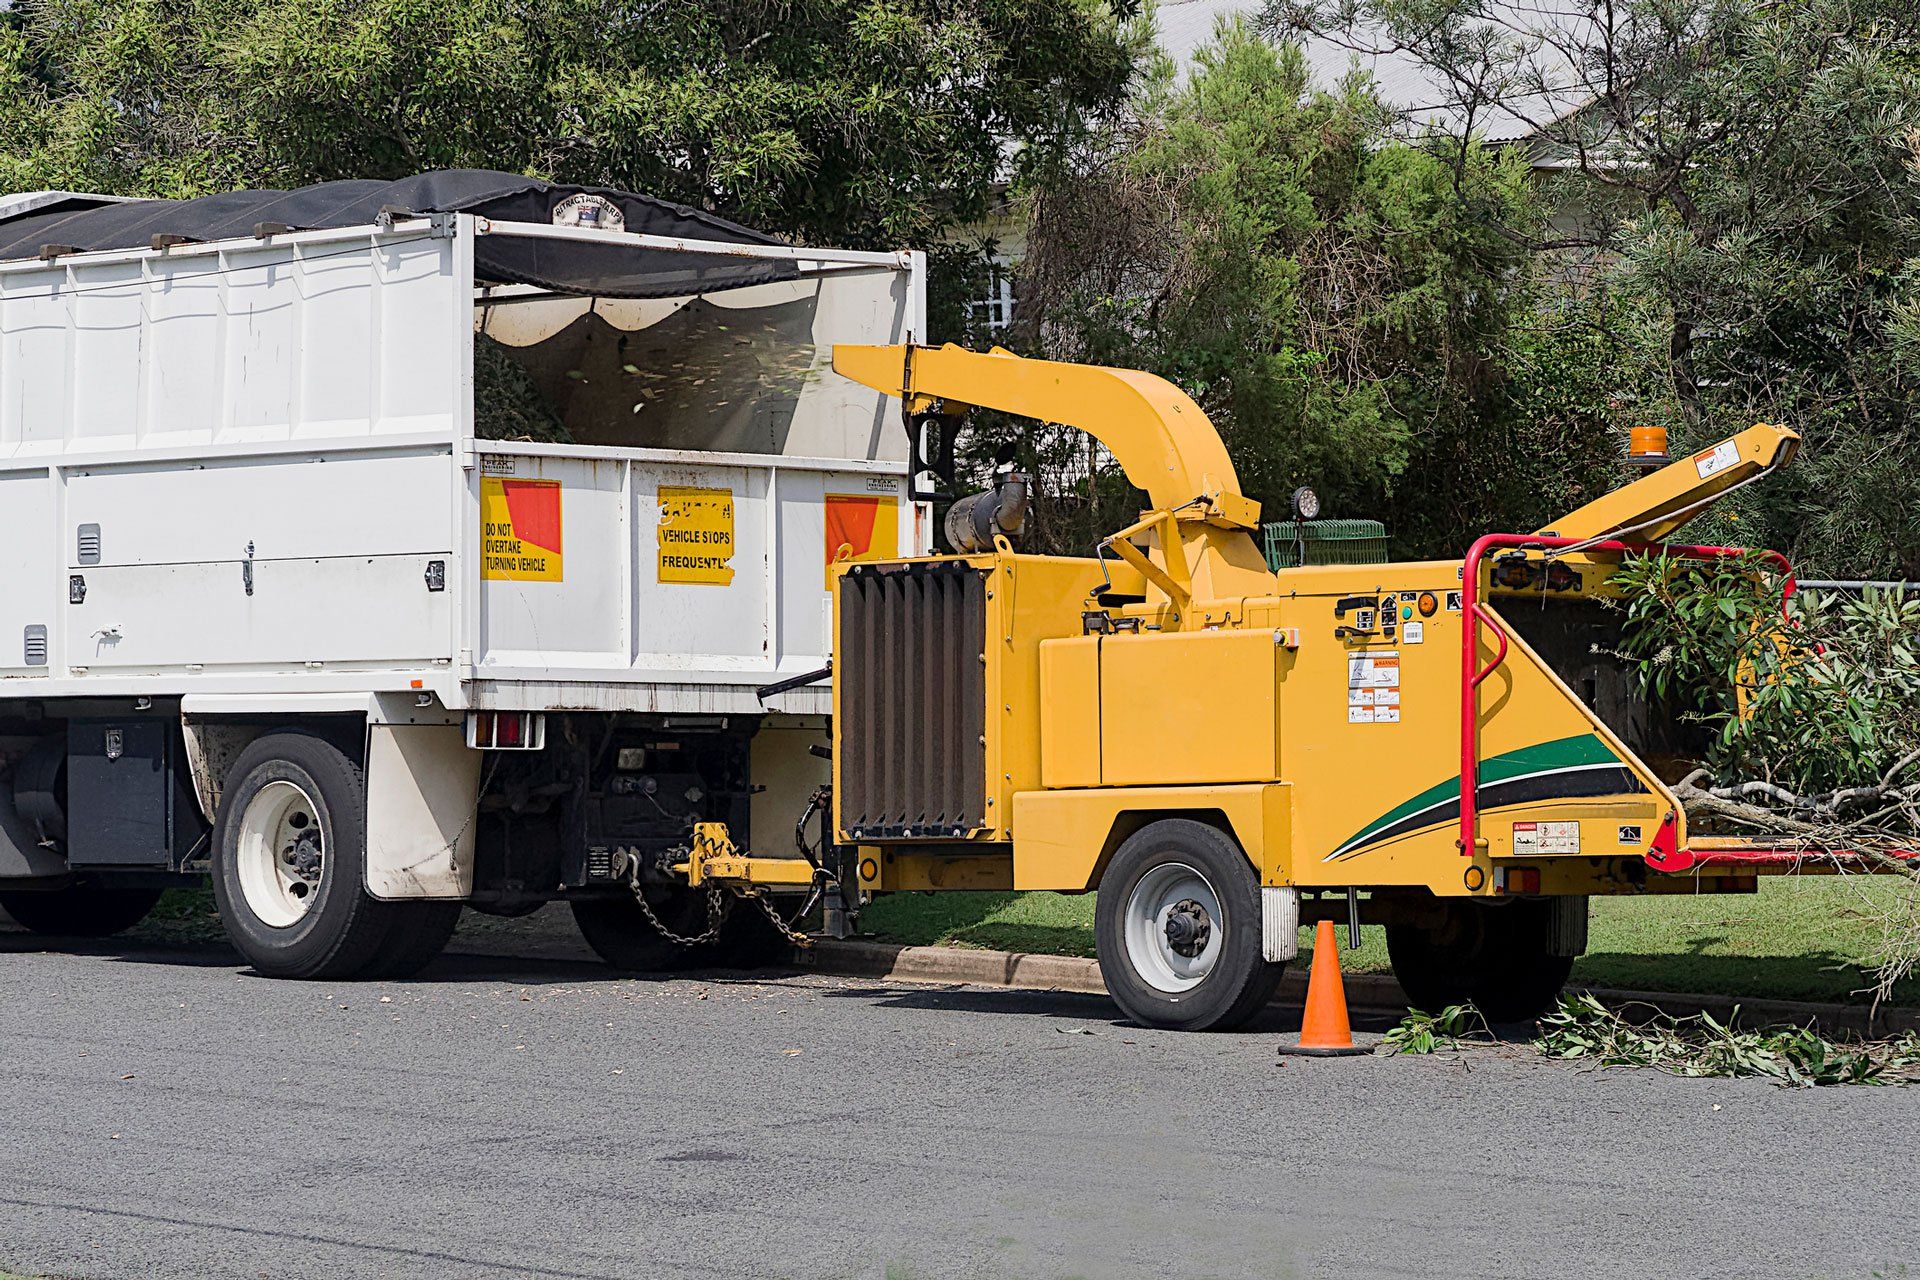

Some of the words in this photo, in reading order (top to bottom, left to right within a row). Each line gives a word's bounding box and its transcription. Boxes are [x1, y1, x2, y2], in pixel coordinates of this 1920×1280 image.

[485, 522, 496, 536] DO
[497, 523, 512, 537] NOT
[662, 529, 700, 543] VEHICLE
[702, 530, 730, 544] STOPS
[485, 539, 522, 554] OVERTAKE
[485, 556, 516, 571] TURNING
[517, 557, 546, 572] VEHICLE
